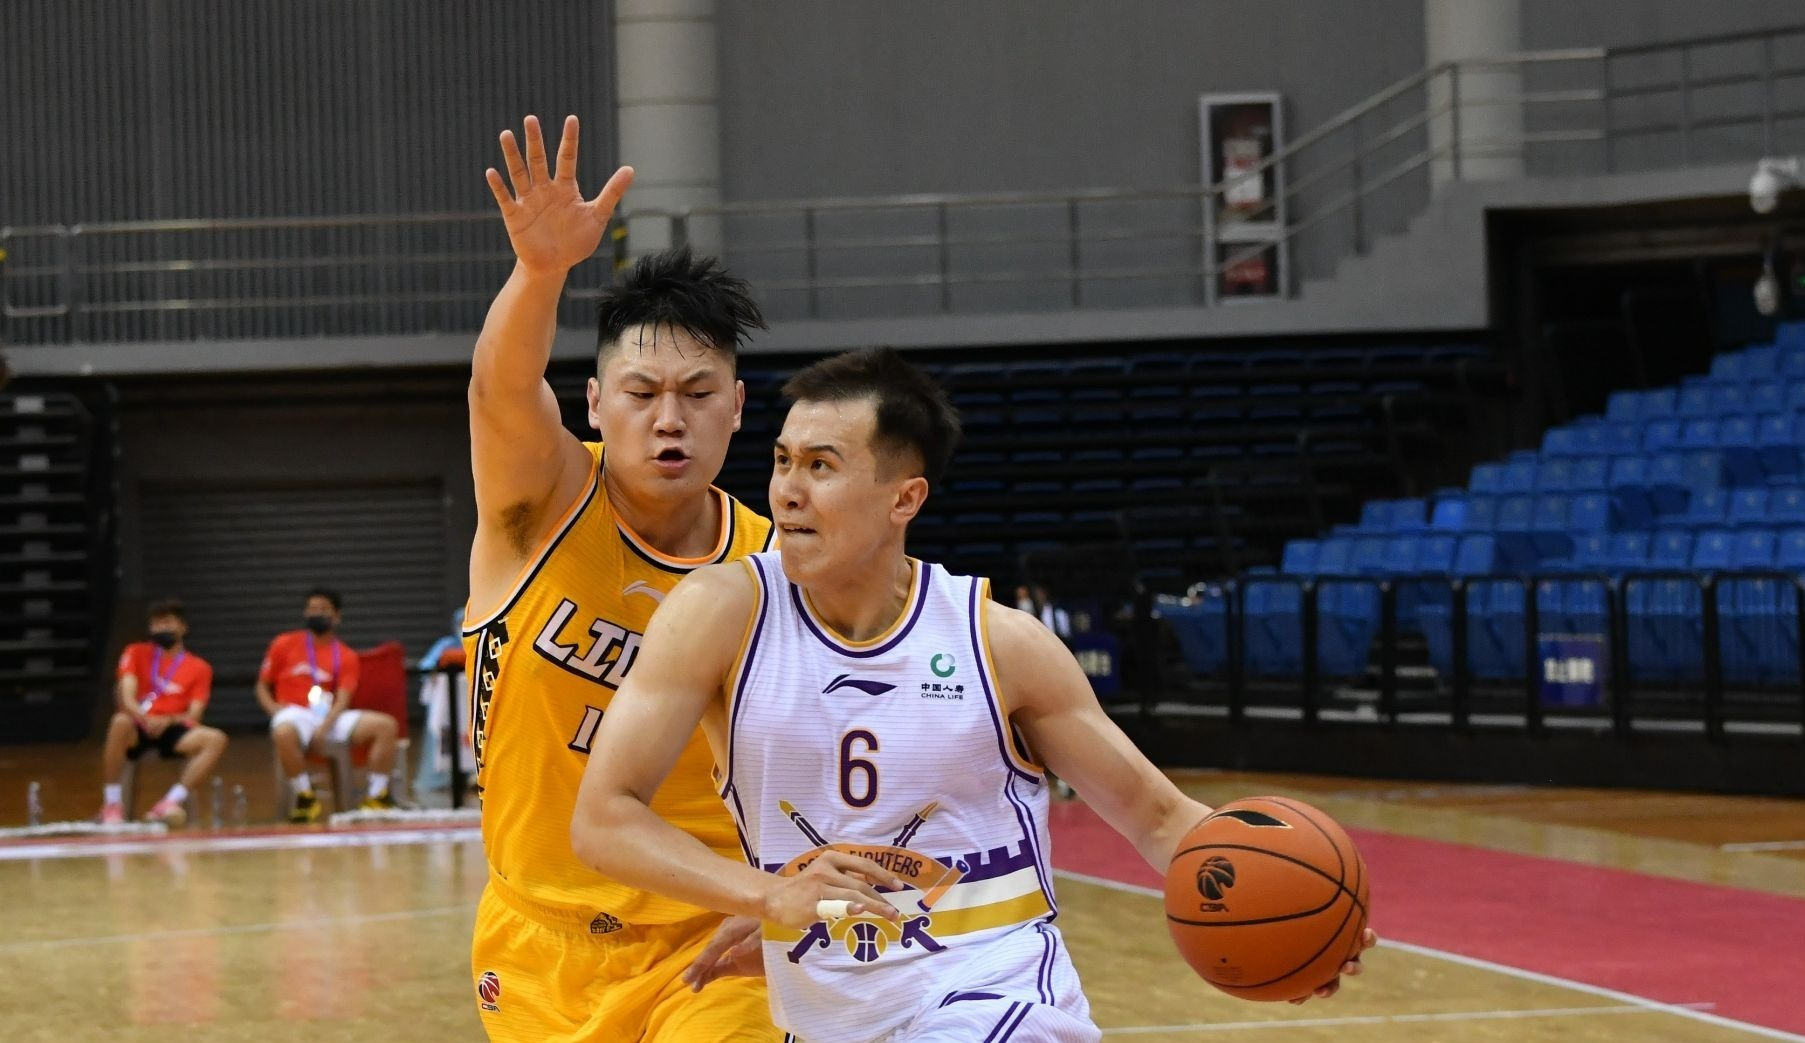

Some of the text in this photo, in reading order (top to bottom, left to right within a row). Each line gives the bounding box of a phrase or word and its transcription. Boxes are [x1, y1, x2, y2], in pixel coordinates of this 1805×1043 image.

[921, 683, 964, 693] 中国人寿
[839, 728, 880, 810] 6
